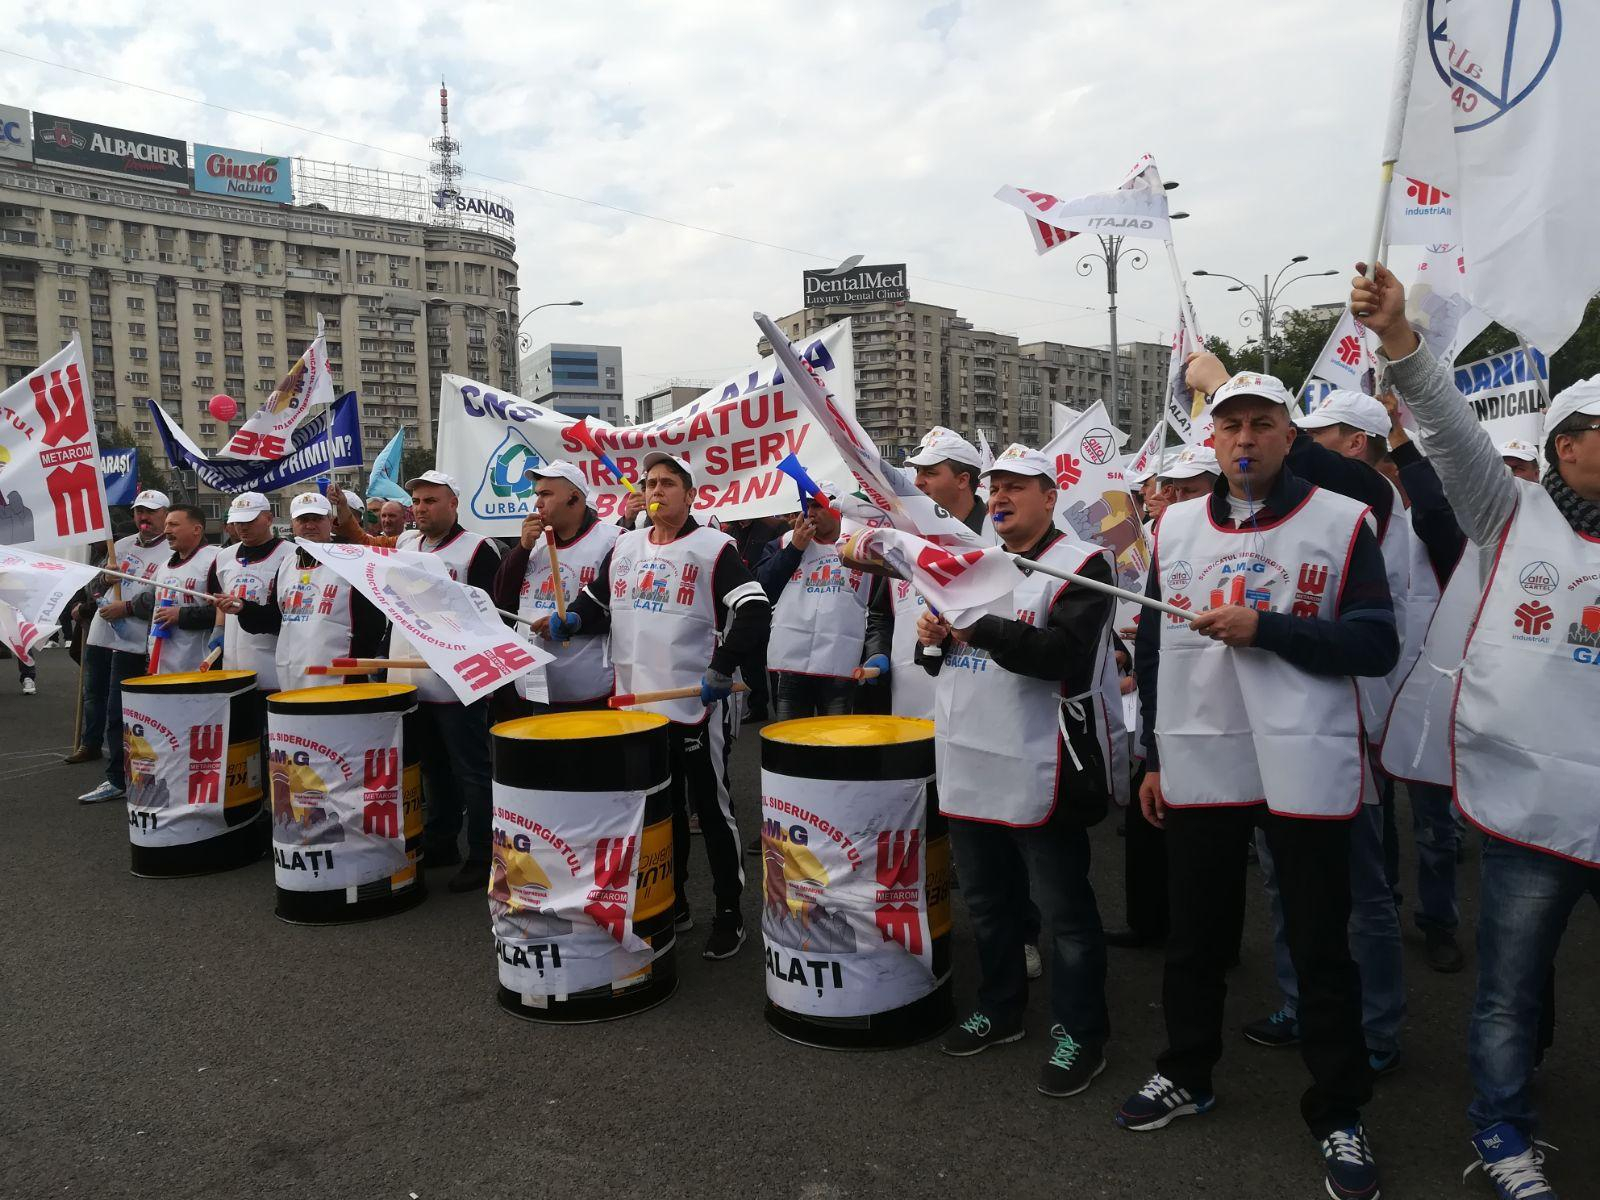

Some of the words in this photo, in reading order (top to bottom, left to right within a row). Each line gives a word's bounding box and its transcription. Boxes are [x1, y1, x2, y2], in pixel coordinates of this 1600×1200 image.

[90, 132, 184, 168] ALBACHER
[206, 153, 278, 183] Giusto
[227, 179, 274, 194] Natura
[456, 196, 515, 226] SANADOR
[806, 270, 904, 294] DentalMed
[807, 294, 841, 304] Luxury
[844, 291, 874, 302] Dental
[877, 289, 904, 300] Clinic
[461, 385, 544, 422] CNS
[41, 446, 92, 464] METAROM
[705, 423, 811, 476] SERV
[1222, 562, 1266, 573] A.M.G
[1528, 575, 1550, 585] alfa
[276, 732, 353, 782] SIDERURGISTUL
[498, 807, 582, 877] SIDERURGISTUL
[769, 796, 862, 872] SIDERURGISTUL
[588, 890, 628, 902] METAROM
[876, 890, 919, 900] METAROM
